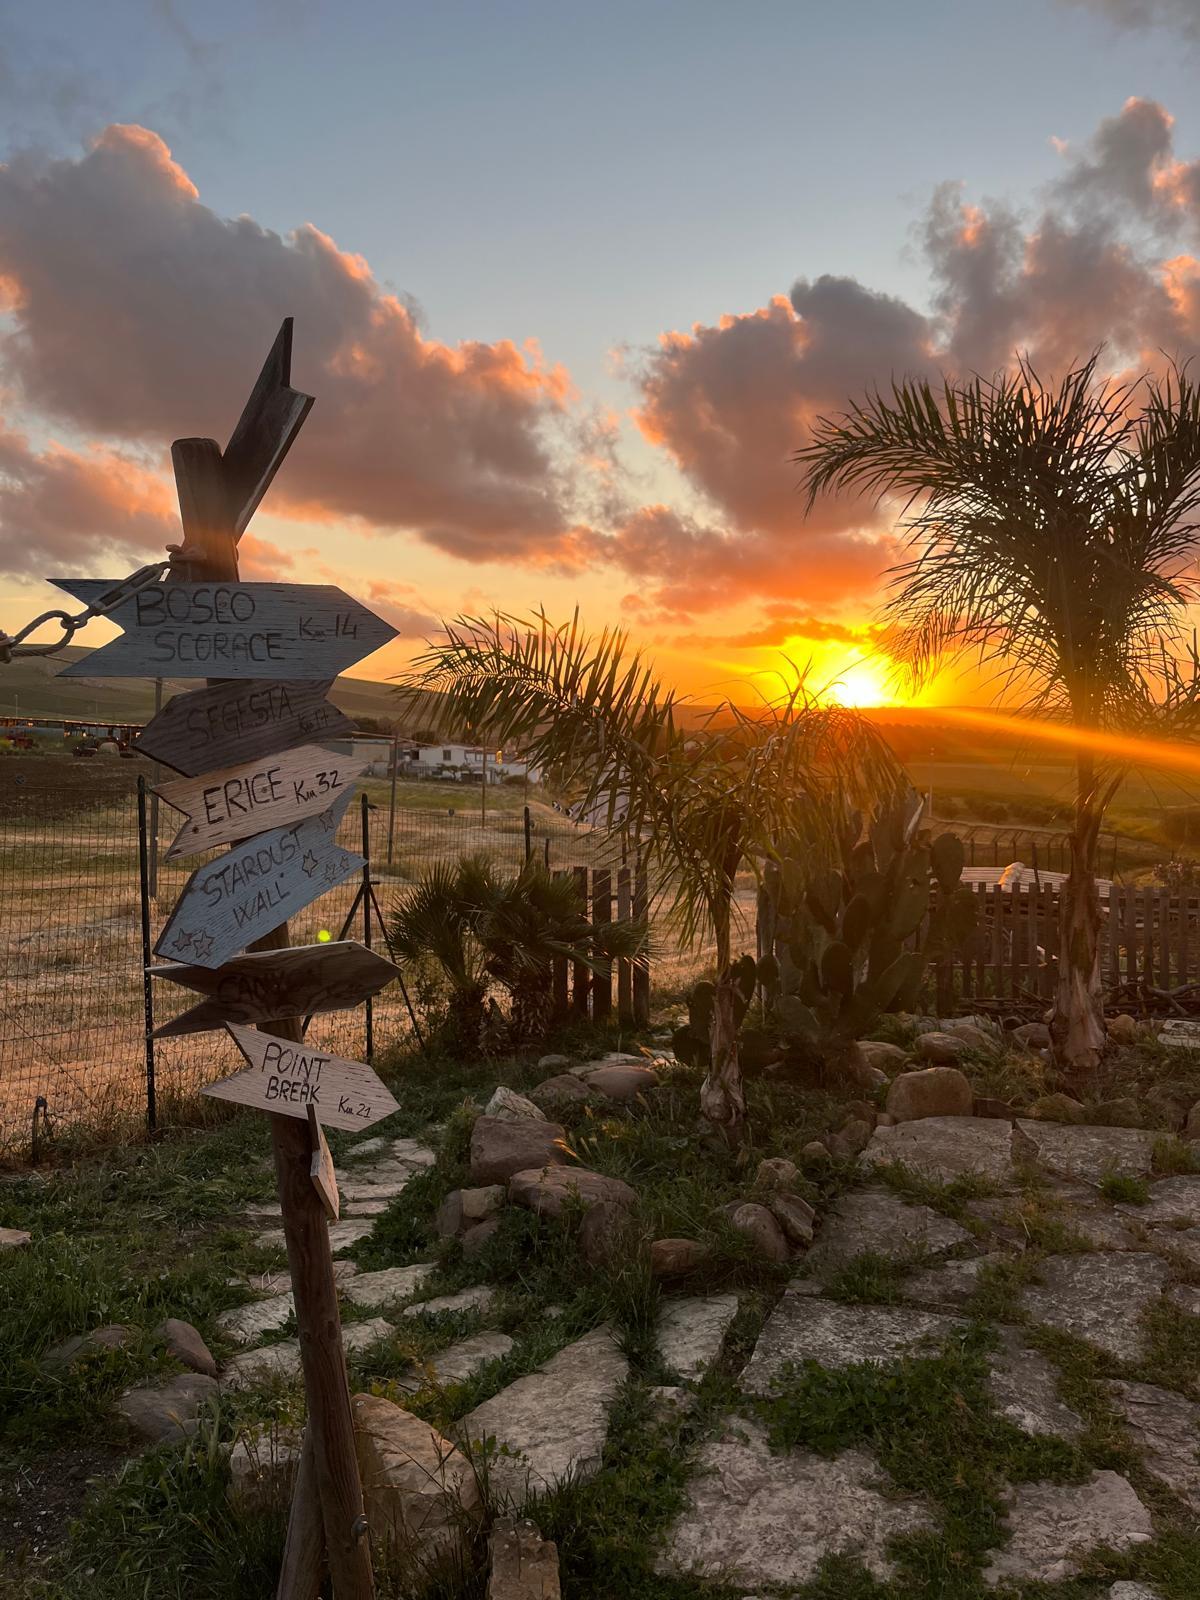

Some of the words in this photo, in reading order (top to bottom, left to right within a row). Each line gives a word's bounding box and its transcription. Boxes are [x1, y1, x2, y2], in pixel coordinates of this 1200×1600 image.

[187, 686, 294, 750] SEGESTA
[203, 767, 283, 824] ERICE
[316, 769, 344, 794] 32
[202, 823, 304, 907] STARDUST
[232, 881, 291, 928] WALL
[261, 1042, 331, 1082] POINT
[265, 1075, 321, 1104] BREAK
[355, 1103, 372, 1119] 21
